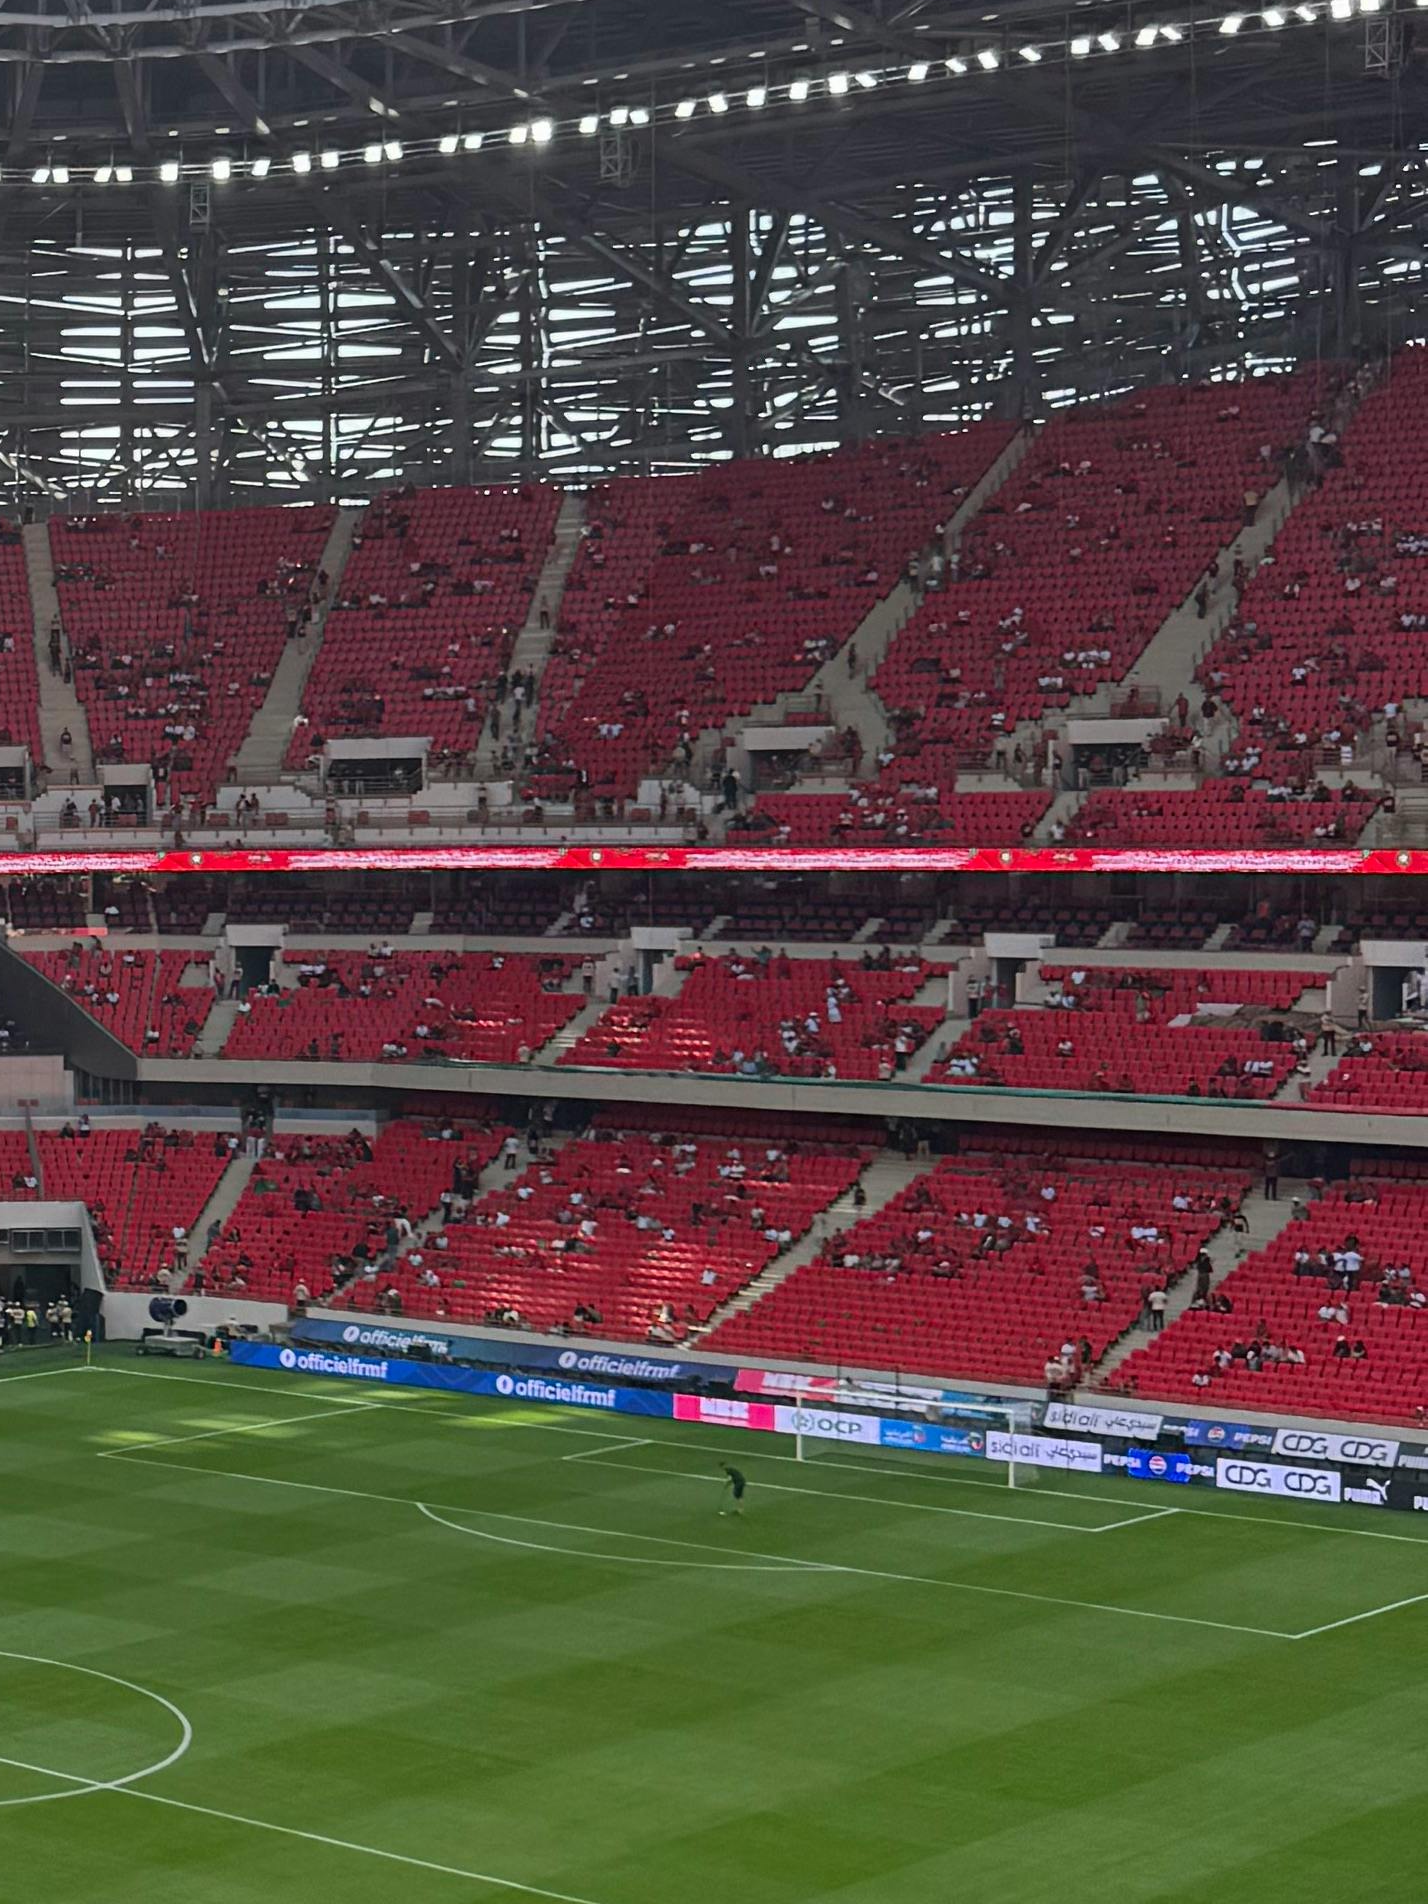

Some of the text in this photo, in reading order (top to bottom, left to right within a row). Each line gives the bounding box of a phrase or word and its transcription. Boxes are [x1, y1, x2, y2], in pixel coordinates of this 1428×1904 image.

[298, 1353, 388, 1379] officielfrmf
[578, 1355, 681, 1379] officielfrmf
[515, 1379, 616, 1407] officielfrmf
[817, 1417, 862, 1435] OCP
[1078, 1413, 1098, 1427] ali
[1234, 1432, 1272, 1446] PEPSI
[1282, 1434, 1328, 1455] CDG
[1340, 1440, 1388, 1462] CDG
[1103, 1453, 1142, 1469] PEPSI
[1176, 1462, 1214, 1477] PEPSI
[1225, 1464, 1332, 1496] CDG CDG
